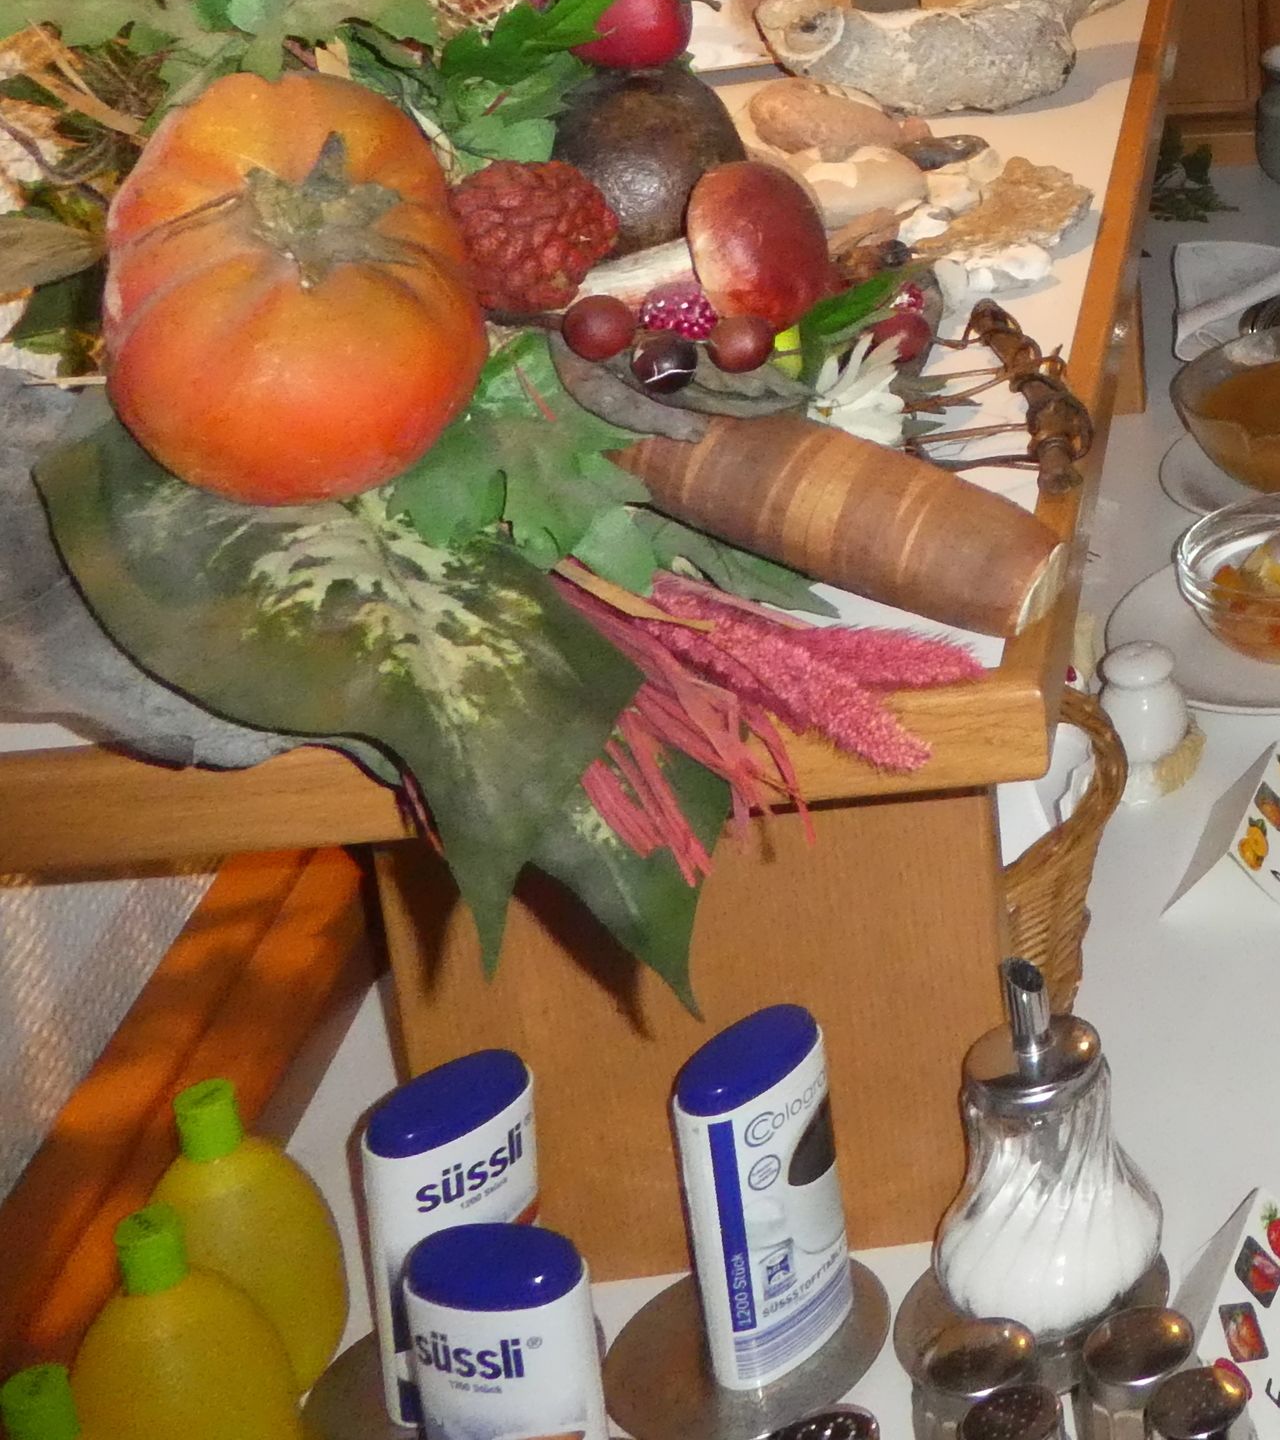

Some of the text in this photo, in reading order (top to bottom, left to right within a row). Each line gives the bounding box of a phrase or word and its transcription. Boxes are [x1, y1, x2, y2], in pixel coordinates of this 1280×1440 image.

[416, 1122, 523, 1213] süssli
[731, 1251, 751, 1327] 1200 Stück
[415, 1330, 525, 1380] süssli
